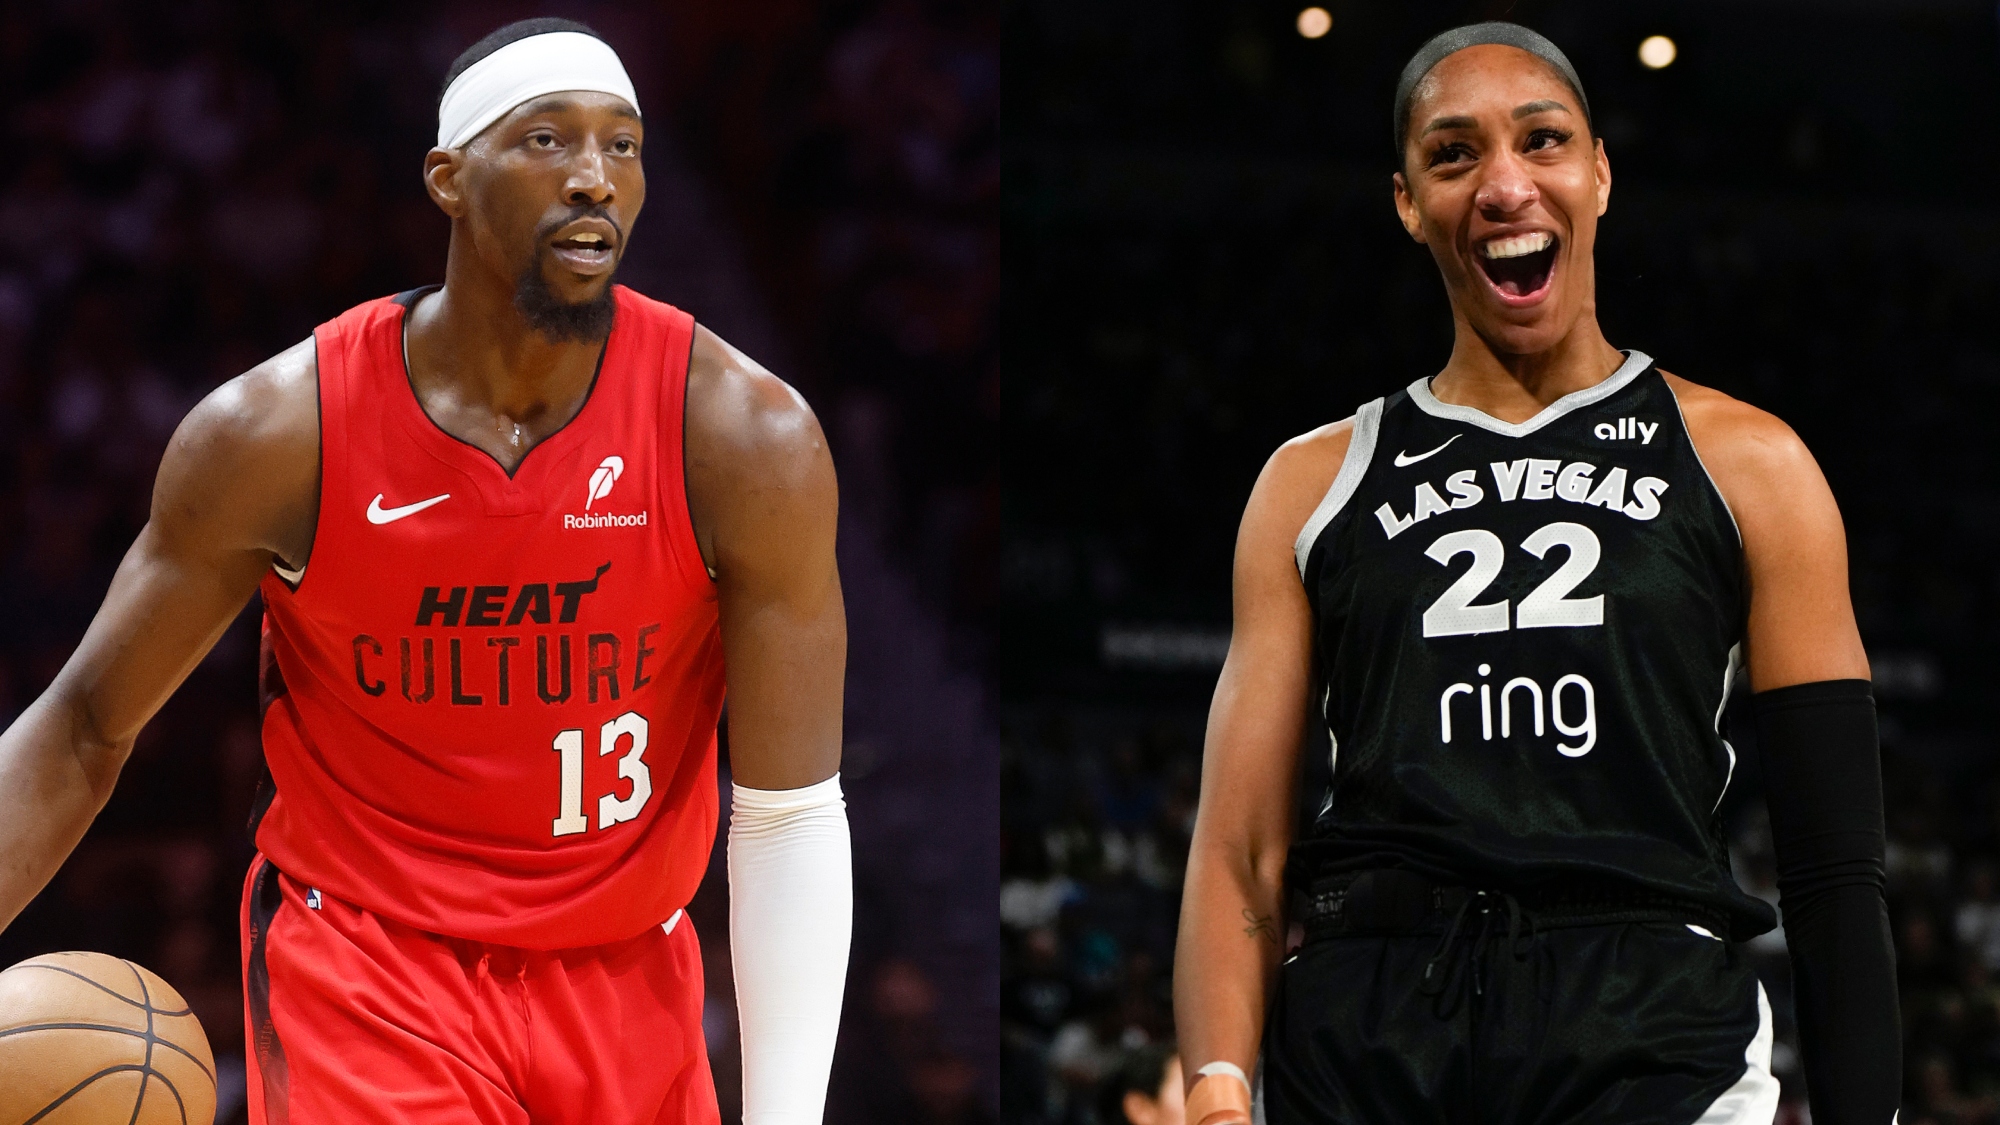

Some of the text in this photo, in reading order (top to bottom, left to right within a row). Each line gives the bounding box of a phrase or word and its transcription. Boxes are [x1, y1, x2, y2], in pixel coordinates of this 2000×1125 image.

[1594, 417, 1660, 445] ally
[564, 510, 648, 530] Robinhood
[1374, 458, 1669, 540] LAS VEGAS
[415, 561, 611, 627] HEAT
[1423, 522, 1605, 638] 22
[351, 622, 662, 706] CULTURE
[1440, 663, 1597, 758] ring
[552, 711, 652, 837] 13
